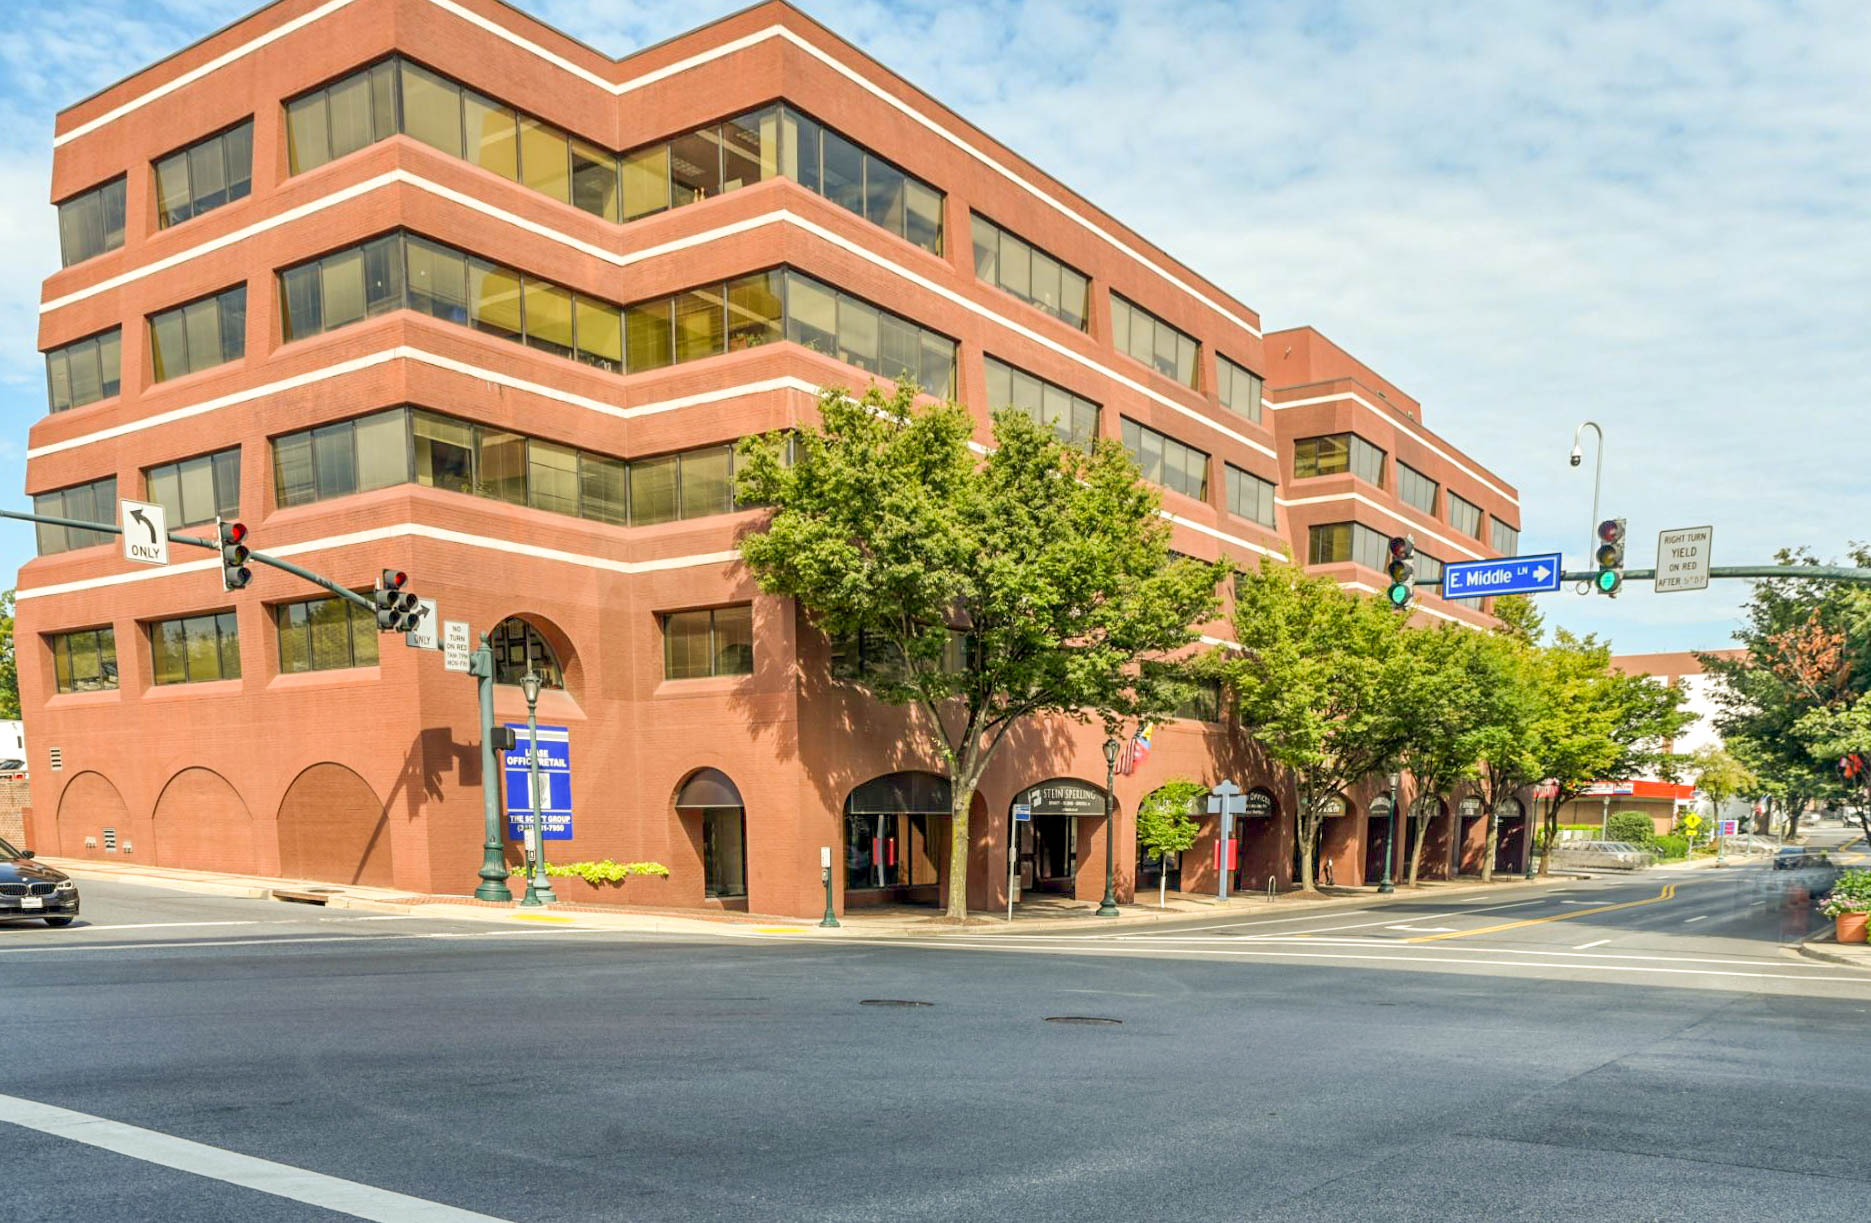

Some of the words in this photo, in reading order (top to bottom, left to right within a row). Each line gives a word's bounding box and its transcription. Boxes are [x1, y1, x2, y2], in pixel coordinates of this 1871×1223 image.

[1664, 535, 1685, 544] RIGHT
[1688, 532, 1706, 542] TURN
[131, 544, 159, 559] ONLY
[1671, 546, 1697, 558] YIELD
[1669, 563, 1679, 572] ON
[1682, 561, 1697, 571] RED
[1450, 572, 1463, 588] E.
[1466, 569, 1512, 587] Middle
[1517, 566, 1528, 576] LN
[1658, 577, 1680, 587] AFTER
[449, 634, 465, 642] TURN
[1043, 788, 1063, 799] STEIN
[1064, 788, 1096, 801] SPERLING
[510, 815, 524, 823] THE
[548, 815, 571, 824] GROUP
